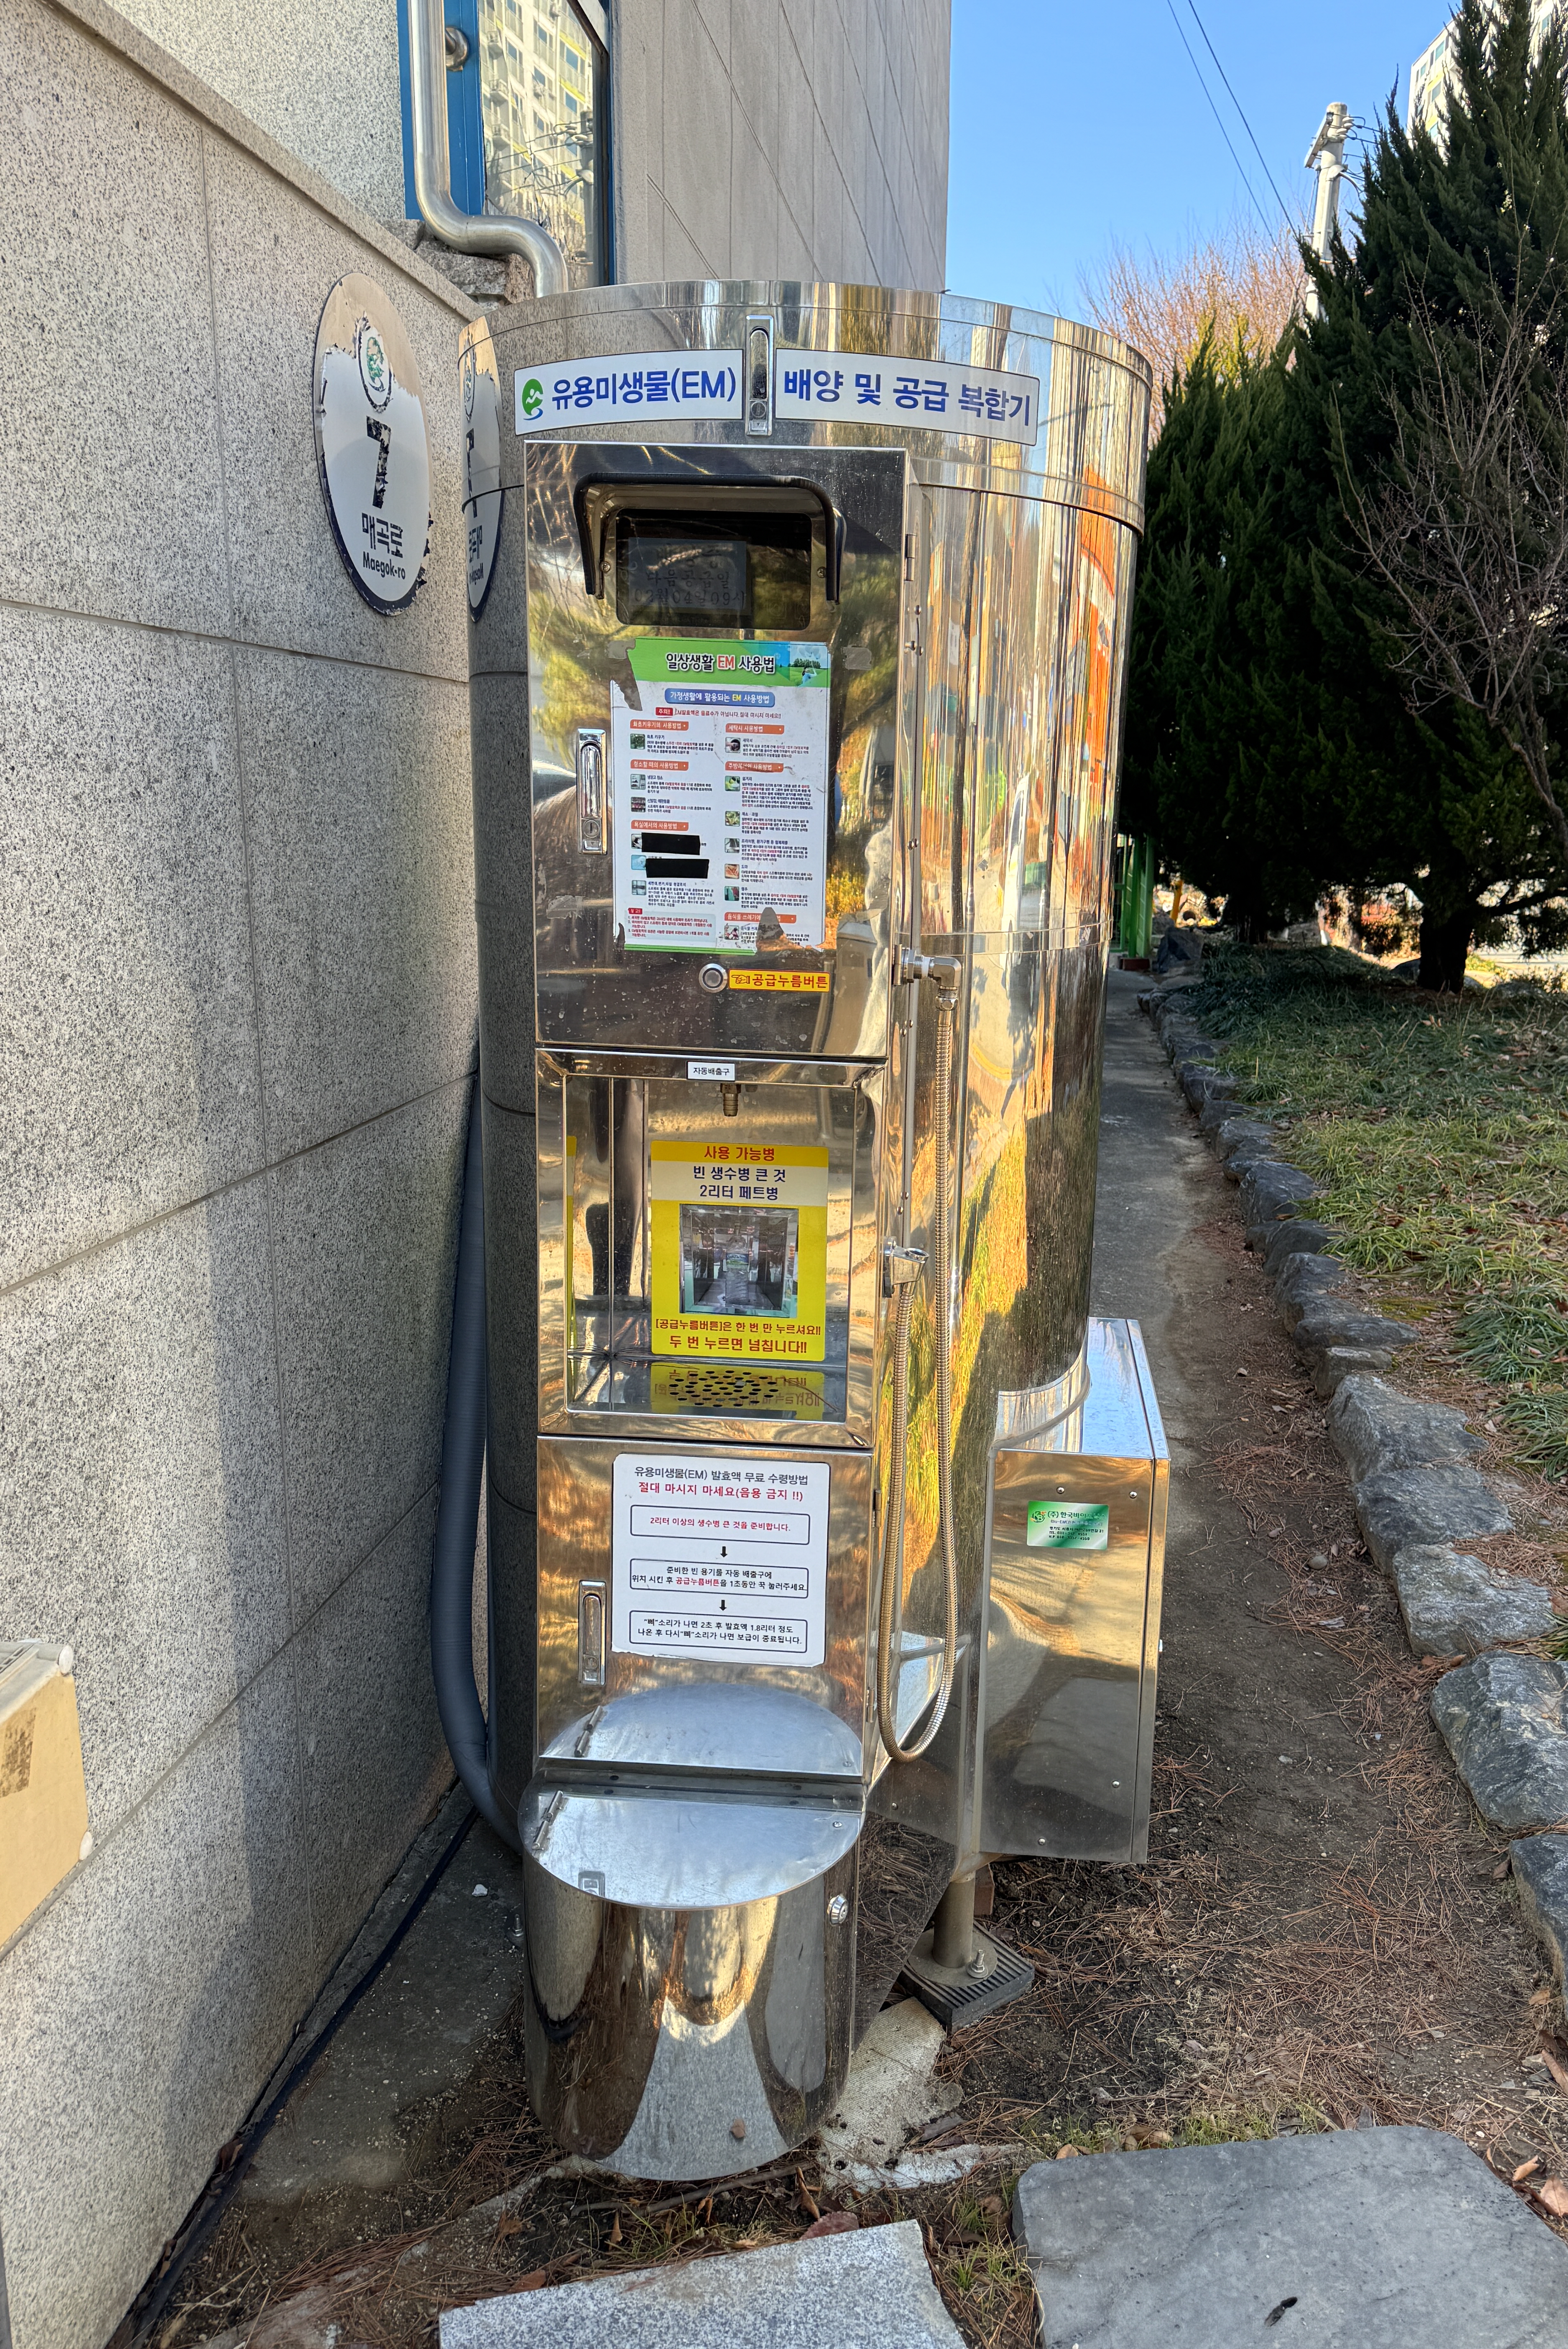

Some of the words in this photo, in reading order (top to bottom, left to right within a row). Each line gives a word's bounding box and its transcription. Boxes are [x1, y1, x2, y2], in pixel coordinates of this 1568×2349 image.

[552, 367, 736, 410] 유용미생물(EM)
[784, 369, 844, 403] 배양
[855, 373, 881, 406] 및
[893, 376, 949, 412] 공급
[958, 384, 1030, 426] 복합기
[361, 512, 403, 558] 매곡로
[363, 551, 406, 580] Maegok-ro
[666, 653, 713, 671] 일상생활
[718, 655, 735, 669] EM
[740, 656, 775, 673] 사용법
[670, 691, 702, 701] 가정생활에
[704, 693, 730, 702] 활용되는
[744, 694, 769, 704] 사용방법
[752, 974, 828, 989] 공급누름버튼
[694, 1067, 730, 1076] 자동배출구
[704, 1146, 730, 1160] 사용
[735, 1147, 775, 1161] 가능병
[694, 1166, 705, 1179] 빈
[710, 1167, 749, 1181] 생수병
[756, 1169, 768, 1182] 큰
[774, 1169, 786, 1182] 것
[700, 1185, 733, 1199] 2리터
[739, 1186, 778, 1200] 페트병
[656, 1319, 732, 1332] [공급누름버튼]은
[736, 1322, 746, 1332] 한
[749, 1322, 759, 1333] 번
[763, 1323, 772, 1334] 만
[776, 1324, 821, 1335] 누르셔요!!
[670, 1336, 682, 1348] 두
[687, 1337, 699, 1349] 번
[705, 1337, 742, 1351] 누르면
[749, 1339, 807, 1354] 넘칩니다!!
[634, 1466, 707, 1480] 유용미생물(EM)
[711, 1471, 741, 1483] 발효액
[745, 1473, 765, 1483] 무료
[768, 1473, 808, 1485] 수령방법
[638, 1482, 659, 1494] 절대
[665, 1484, 696, 1495] 마시지
[703, 1485, 761, 1499] 마세요(음용
[766, 1488, 787, 1500] 금지
[792, 1490, 803, 1501] !!)
[650, 1517, 669, 1526] 2리터
[672, 1518, 694, 1527] 이상의
[698, 1519, 719, 1528] 생수병
[733, 1521, 747, 1530] 것을
[750, 1522, 791, 1532] 준비합니다.
[667, 1566, 689, 1575] 준비한
[691, 1567, 698, 1575] 빈
[701, 1568, 722, 1577] 용기를
[726, 1569, 740, 1578] 자동
[742, 1570, 772, 1579] 배출구에
[632, 1575, 646, 1584] 위치
[649, 1575, 663, 1584] 시킨
[666, 1576, 673, 1584] 후
[676, 1576, 727, 1587] 공급누름버튼을
[730, 1580, 756, 1589] 1초동안
[683, 1620, 698, 1628] 나면
[716, 1621, 722, 1629] 후
[726, 1622, 747, 1631] 발효액
[751, 1624, 776, 1633] 1.8리터
[778, 1625, 793, 1633] 정도
[655, 1629, 663, 1637] 후
[719, 1631, 735, 1640] 나면
[738, 1633, 759, 1642] 보급이
[762, 1635, 802, 1644] 종료됩니다.
